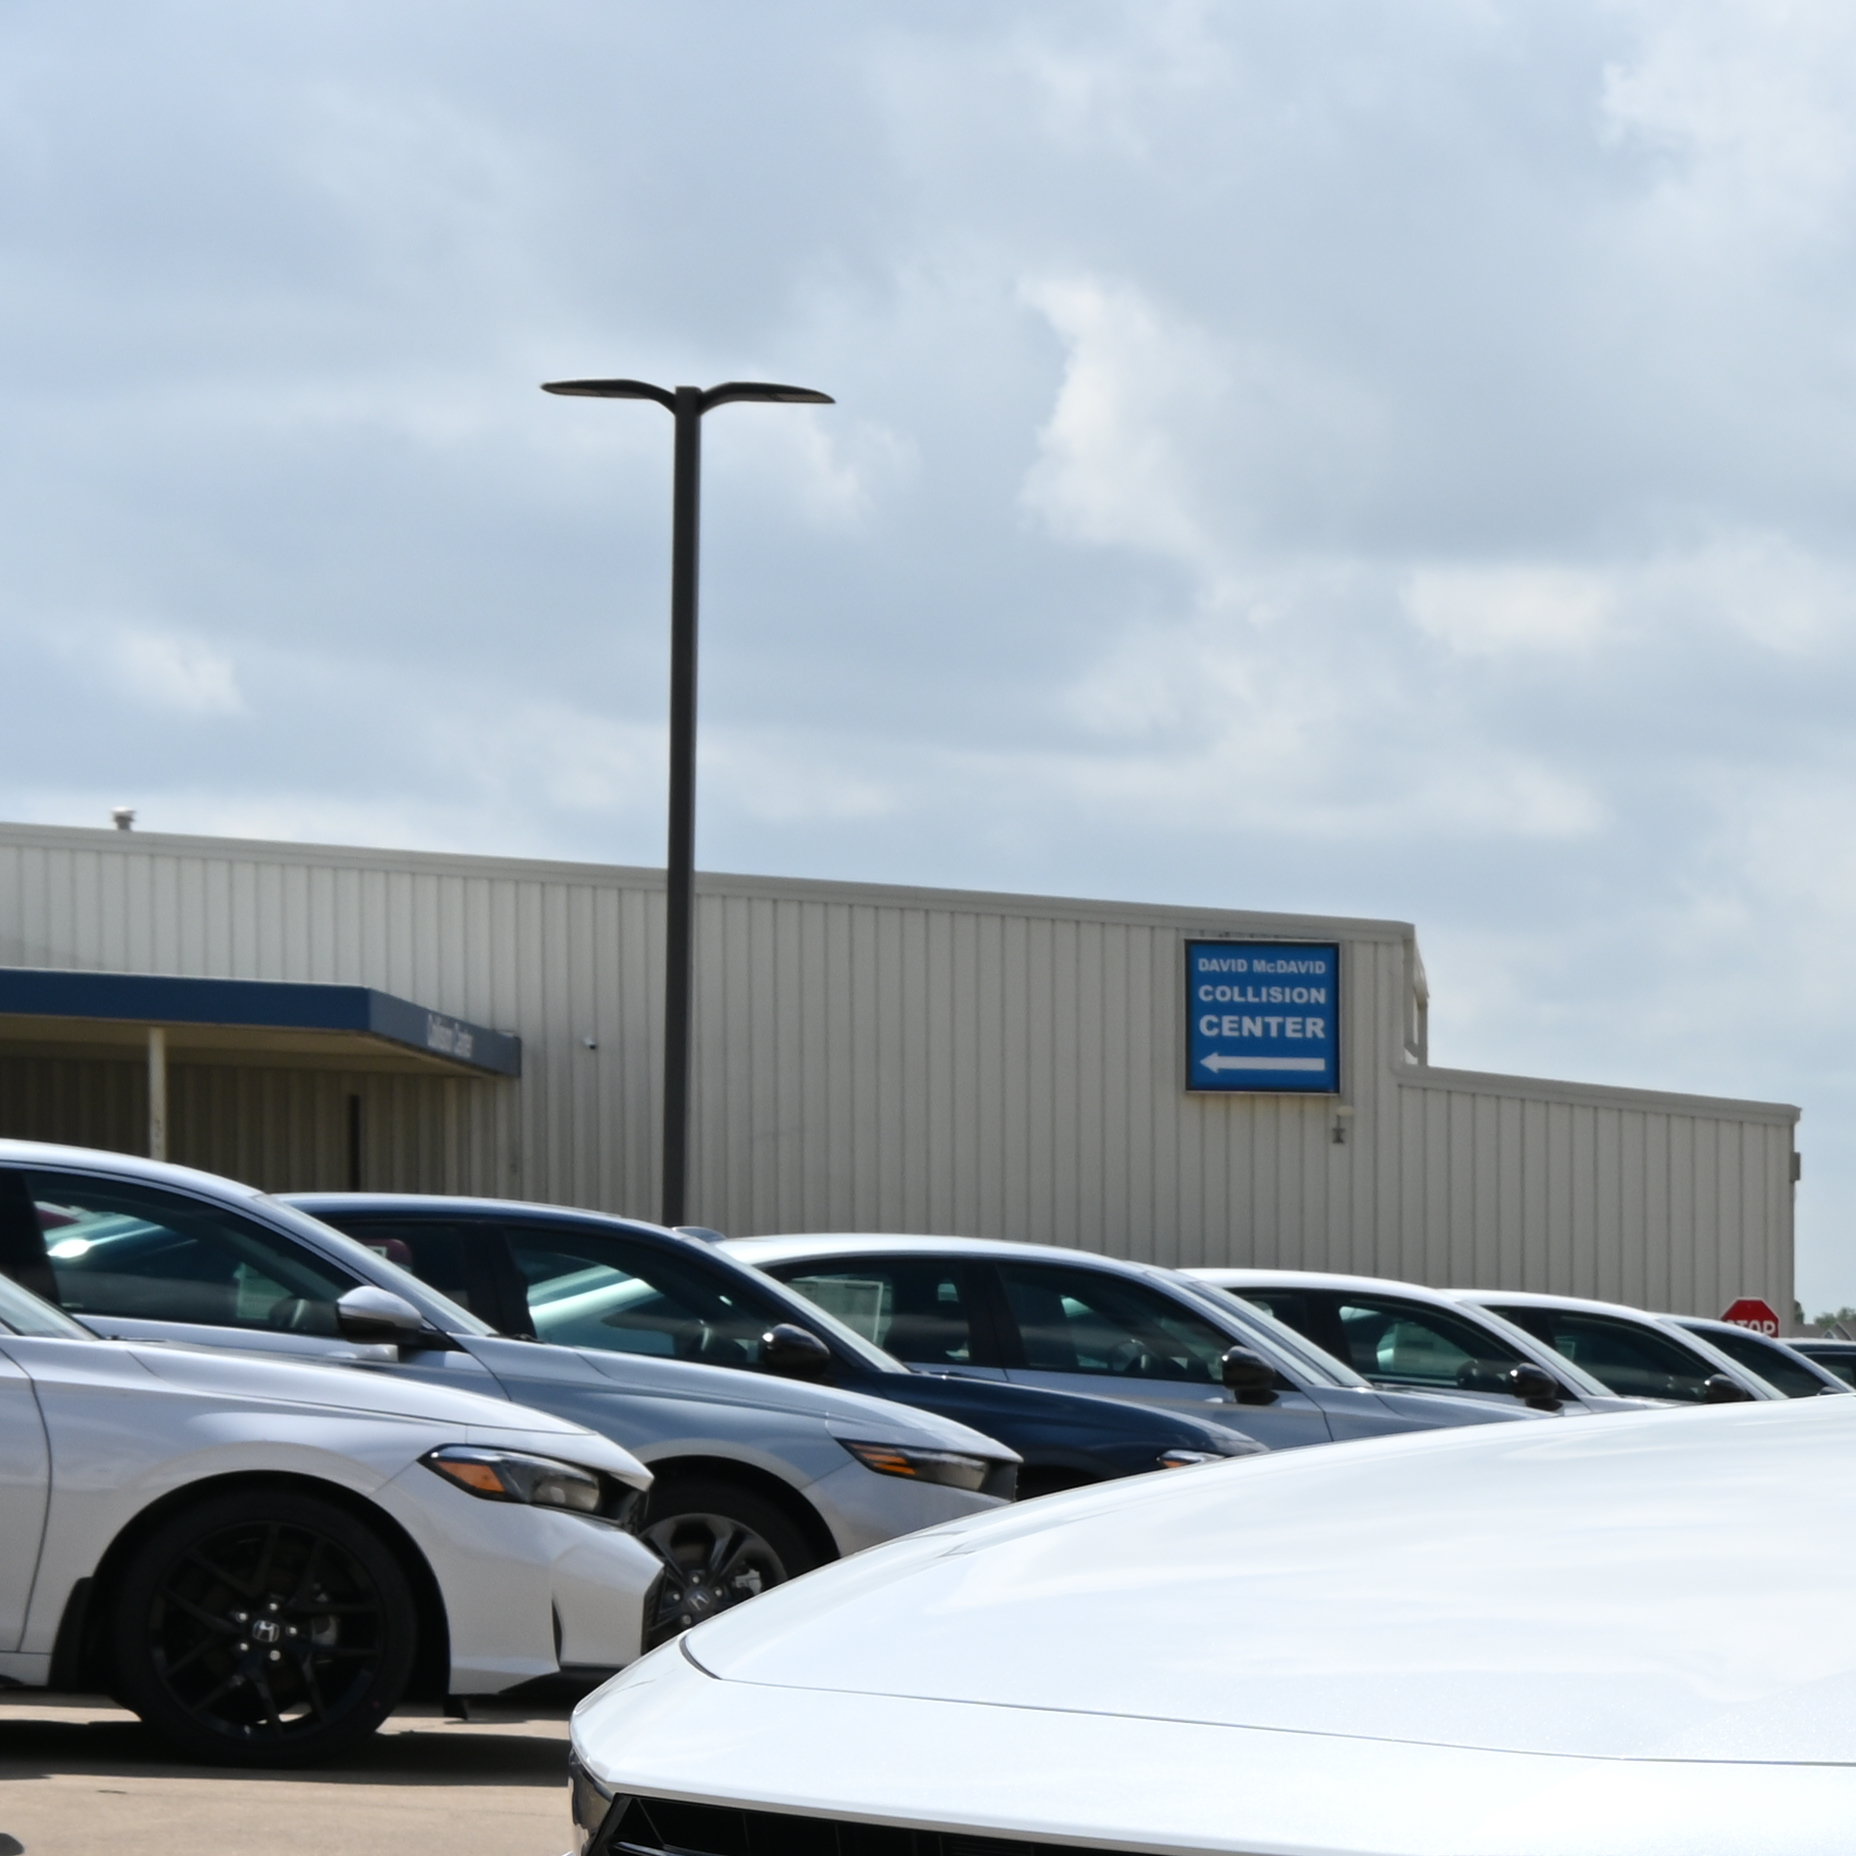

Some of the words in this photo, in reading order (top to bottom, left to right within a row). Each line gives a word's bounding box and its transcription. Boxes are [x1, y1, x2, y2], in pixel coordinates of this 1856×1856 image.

[1198, 958, 1248, 973] DAVID
[1252, 959, 1326, 974] McDAVID
[1198, 984, 1326, 1004] COLLISION
[1199, 1014, 1326, 1039] CENTER
[1727, 1319, 1776, 1335] TOP
